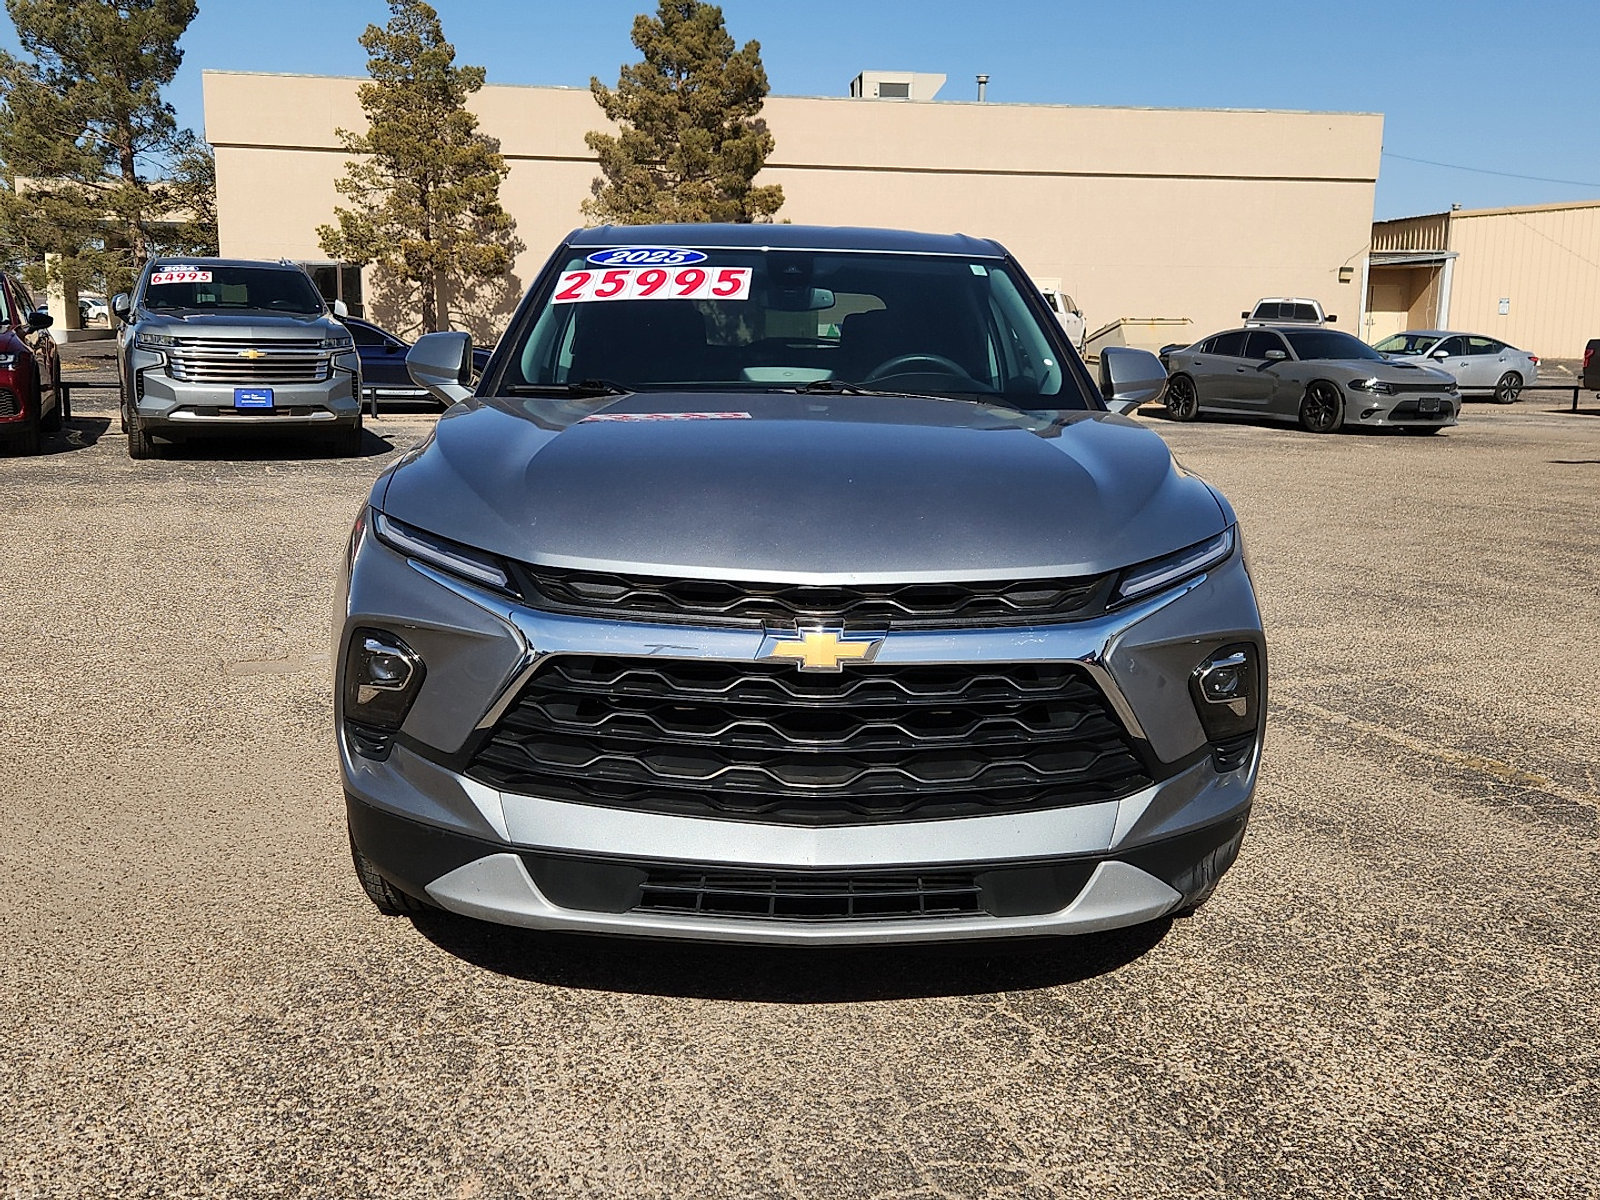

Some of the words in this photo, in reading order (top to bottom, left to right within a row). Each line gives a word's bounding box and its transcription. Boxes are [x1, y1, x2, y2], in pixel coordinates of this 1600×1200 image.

[604, 250, 688, 264] 2025
[153, 272, 209, 283] 64995
[555, 269, 747, 300] 25995
